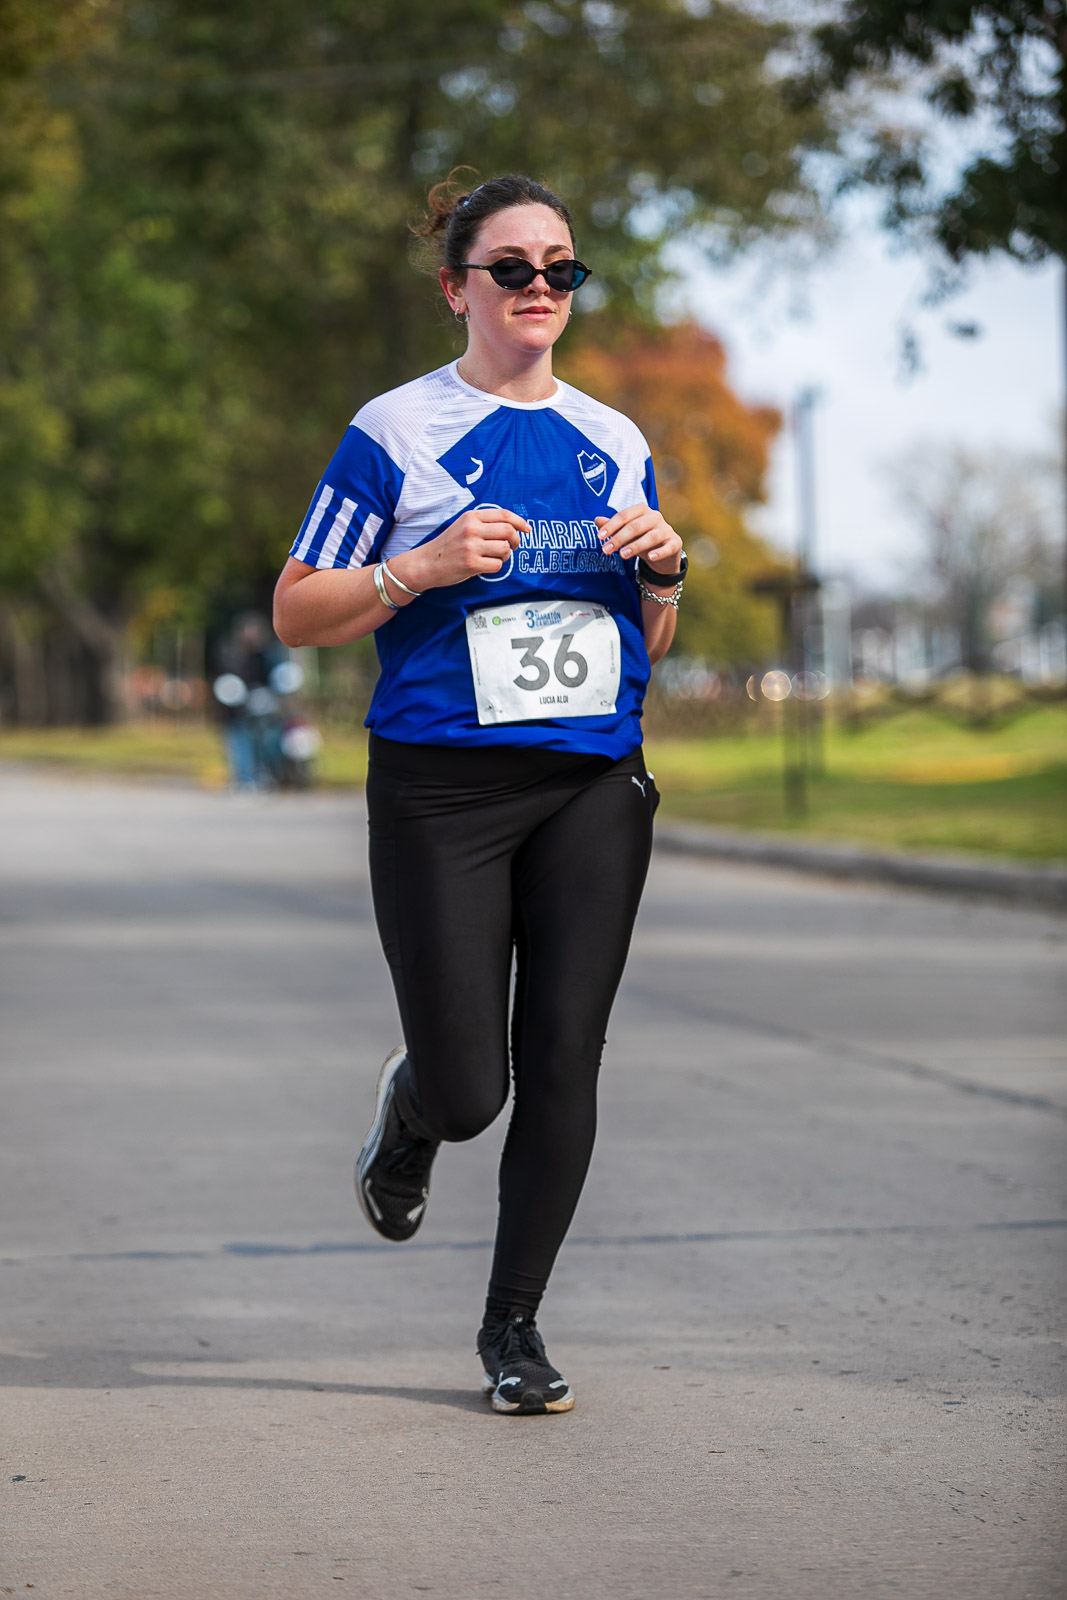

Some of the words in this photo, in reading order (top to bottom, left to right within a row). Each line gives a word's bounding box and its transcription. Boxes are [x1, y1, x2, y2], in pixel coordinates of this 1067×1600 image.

[525, 609, 535, 629] 3
[511, 634, 588, 691] 36
[539, 696, 556, 705] LUCIA
